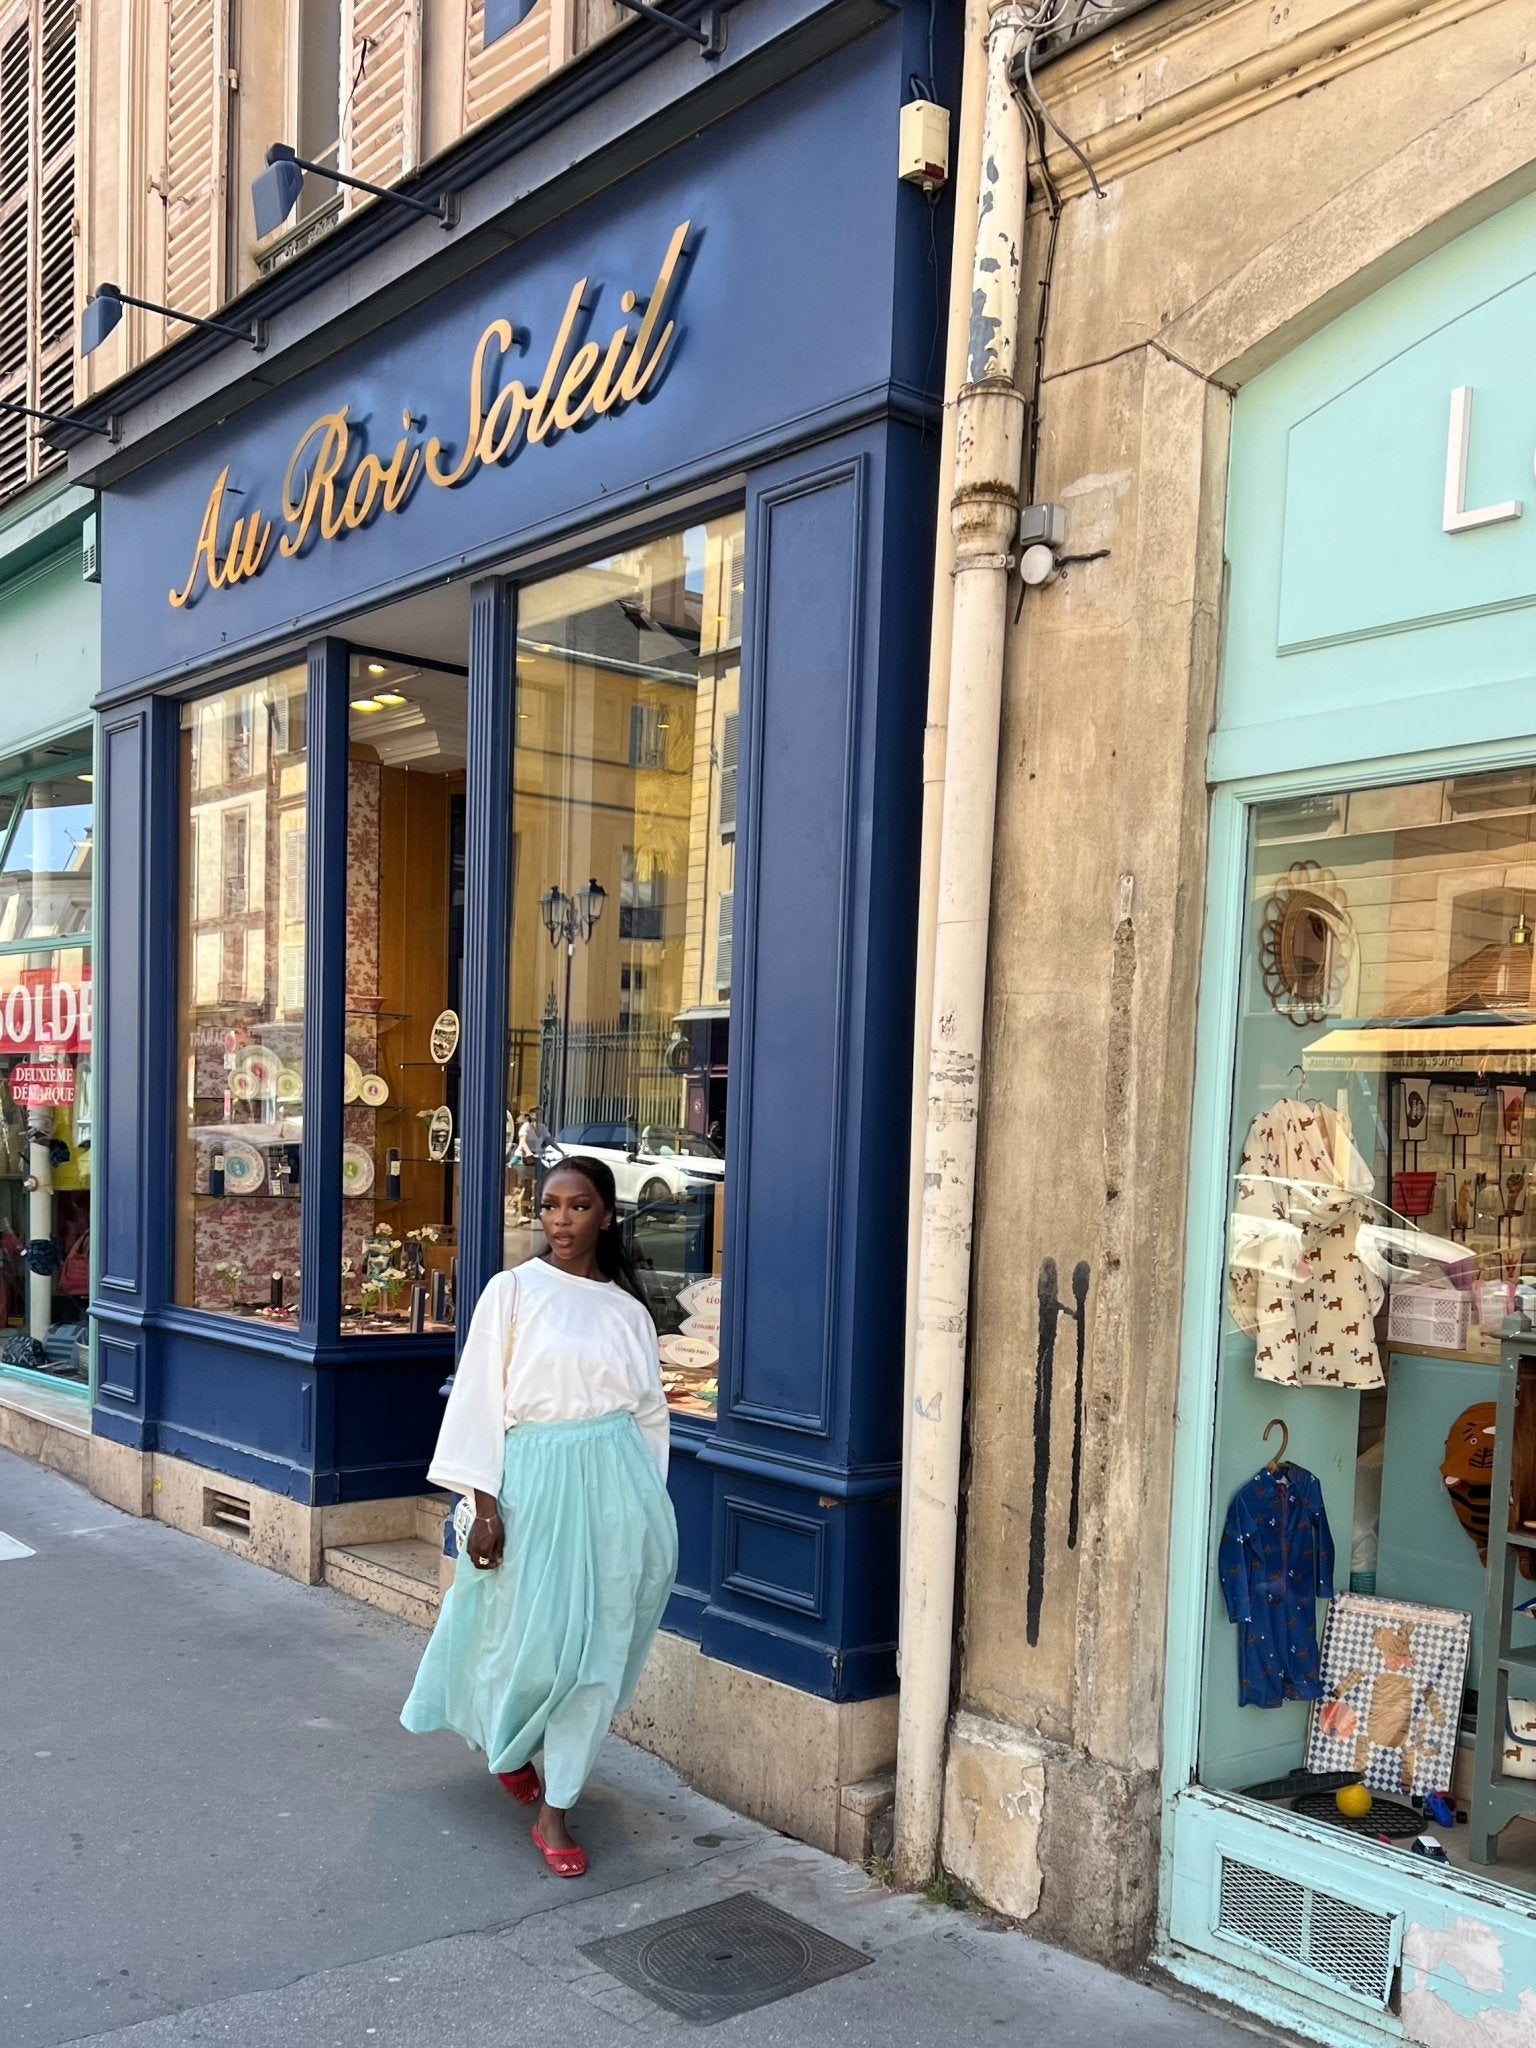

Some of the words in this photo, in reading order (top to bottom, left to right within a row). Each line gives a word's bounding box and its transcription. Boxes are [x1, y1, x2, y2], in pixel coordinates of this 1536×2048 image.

[169, 465, 271, 608] Au
[280, 405, 420, 557] Roi
[425, 219, 692, 488] Soleil
[1443, 385, 1536, 535] L
[0, 981, 92, 1043] OLDE
[13, 1085, 75, 1105] DÉMARQUE
[15, 1065, 73, 1082] DEUXIÈME
